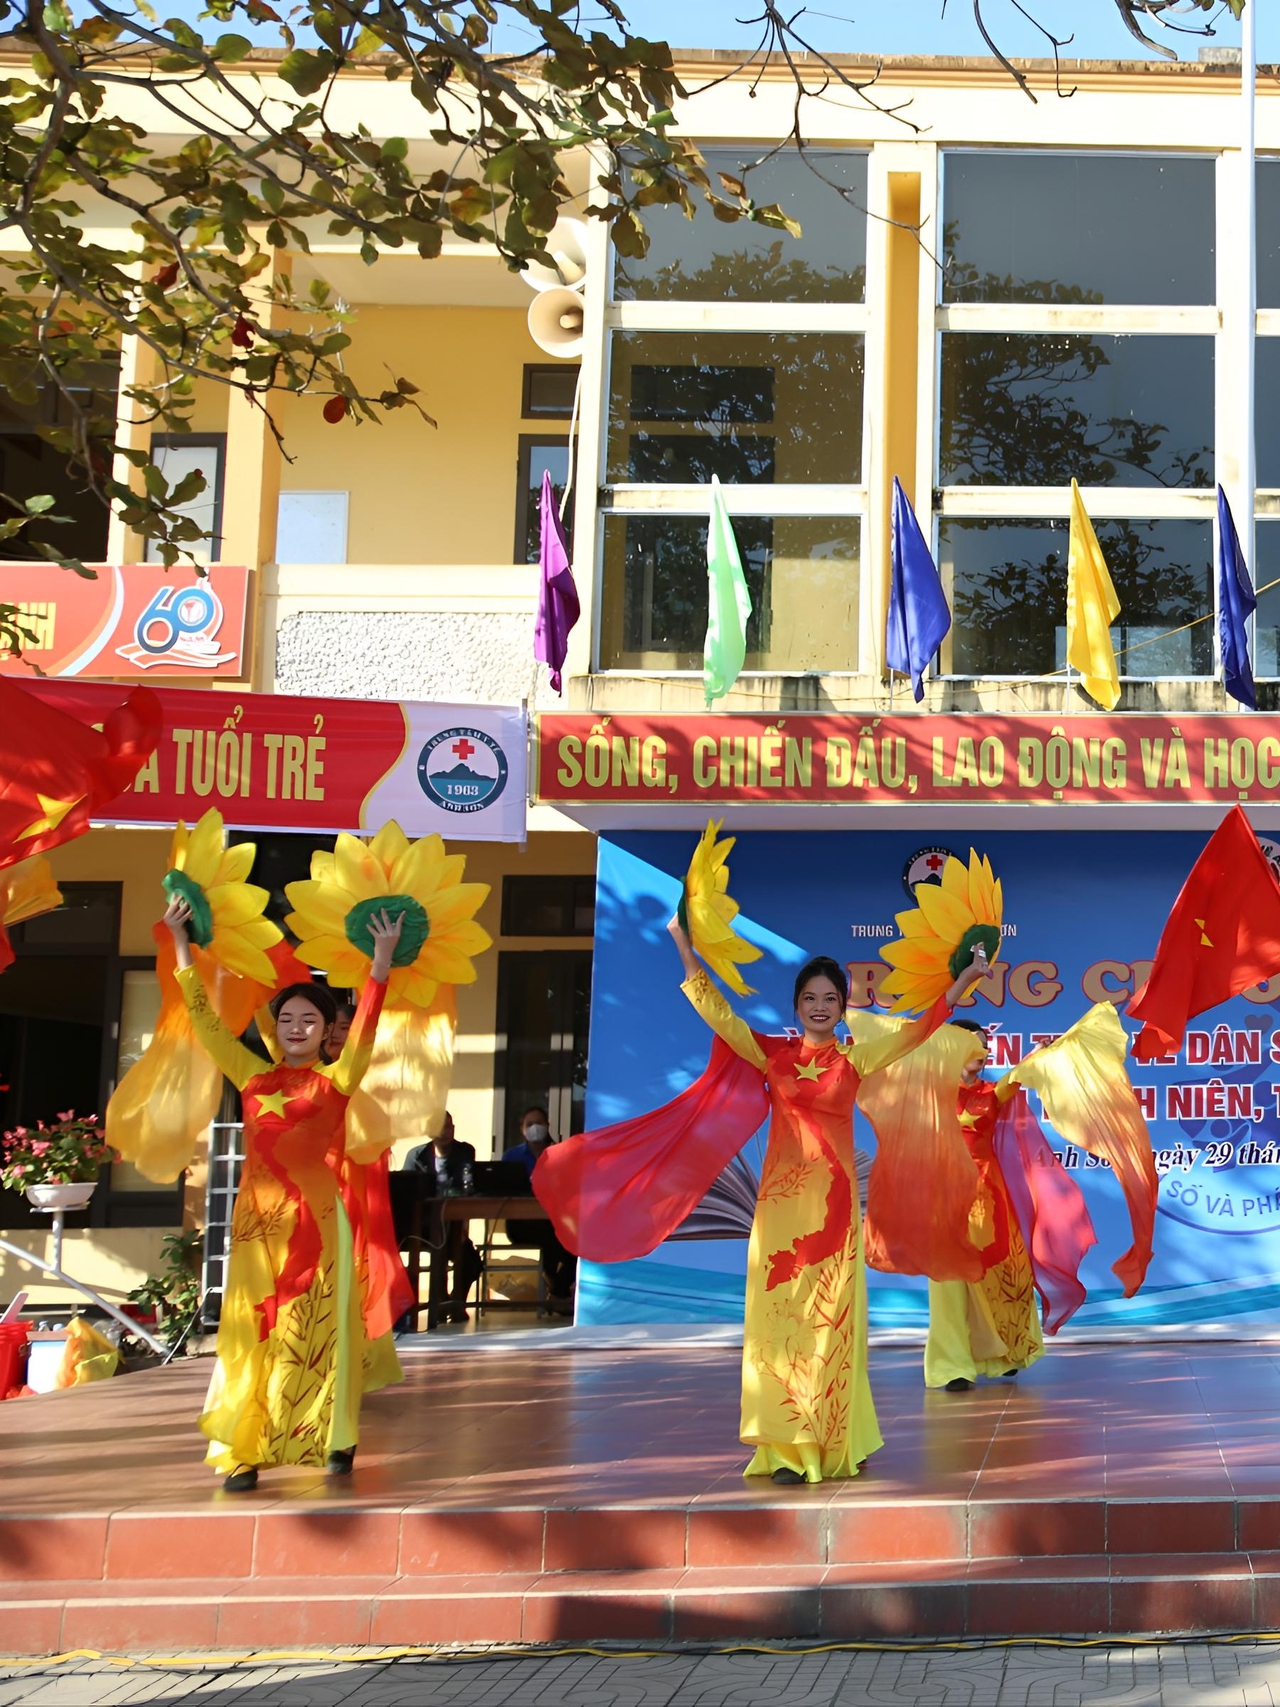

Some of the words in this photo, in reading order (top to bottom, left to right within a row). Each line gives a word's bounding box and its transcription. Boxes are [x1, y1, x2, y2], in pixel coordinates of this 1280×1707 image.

[172, 705, 252, 798] TUỔI
[264, 713, 326, 801] TRẺ
[557, 717, 679, 794] SỐNG,
[693, 719, 812, 788] CHIẾN
[825, 718, 918, 794] ĐẤU,
[932, 735, 1004, 788] LAO
[1017, 725, 1127, 799] ĐỘNG
[1140, 726, 1191, 788] VÀ
[852, 925, 893, 937] TRUNG
[846, 960, 1063, 1007] RNG
[1188, 1024, 1261, 1064] DÂN
[1167, 1079, 1264, 1121] NIÊN,
[1205, 1143, 1231, 1164] 29
[1206, 1194, 1234, 1217] VÀ
